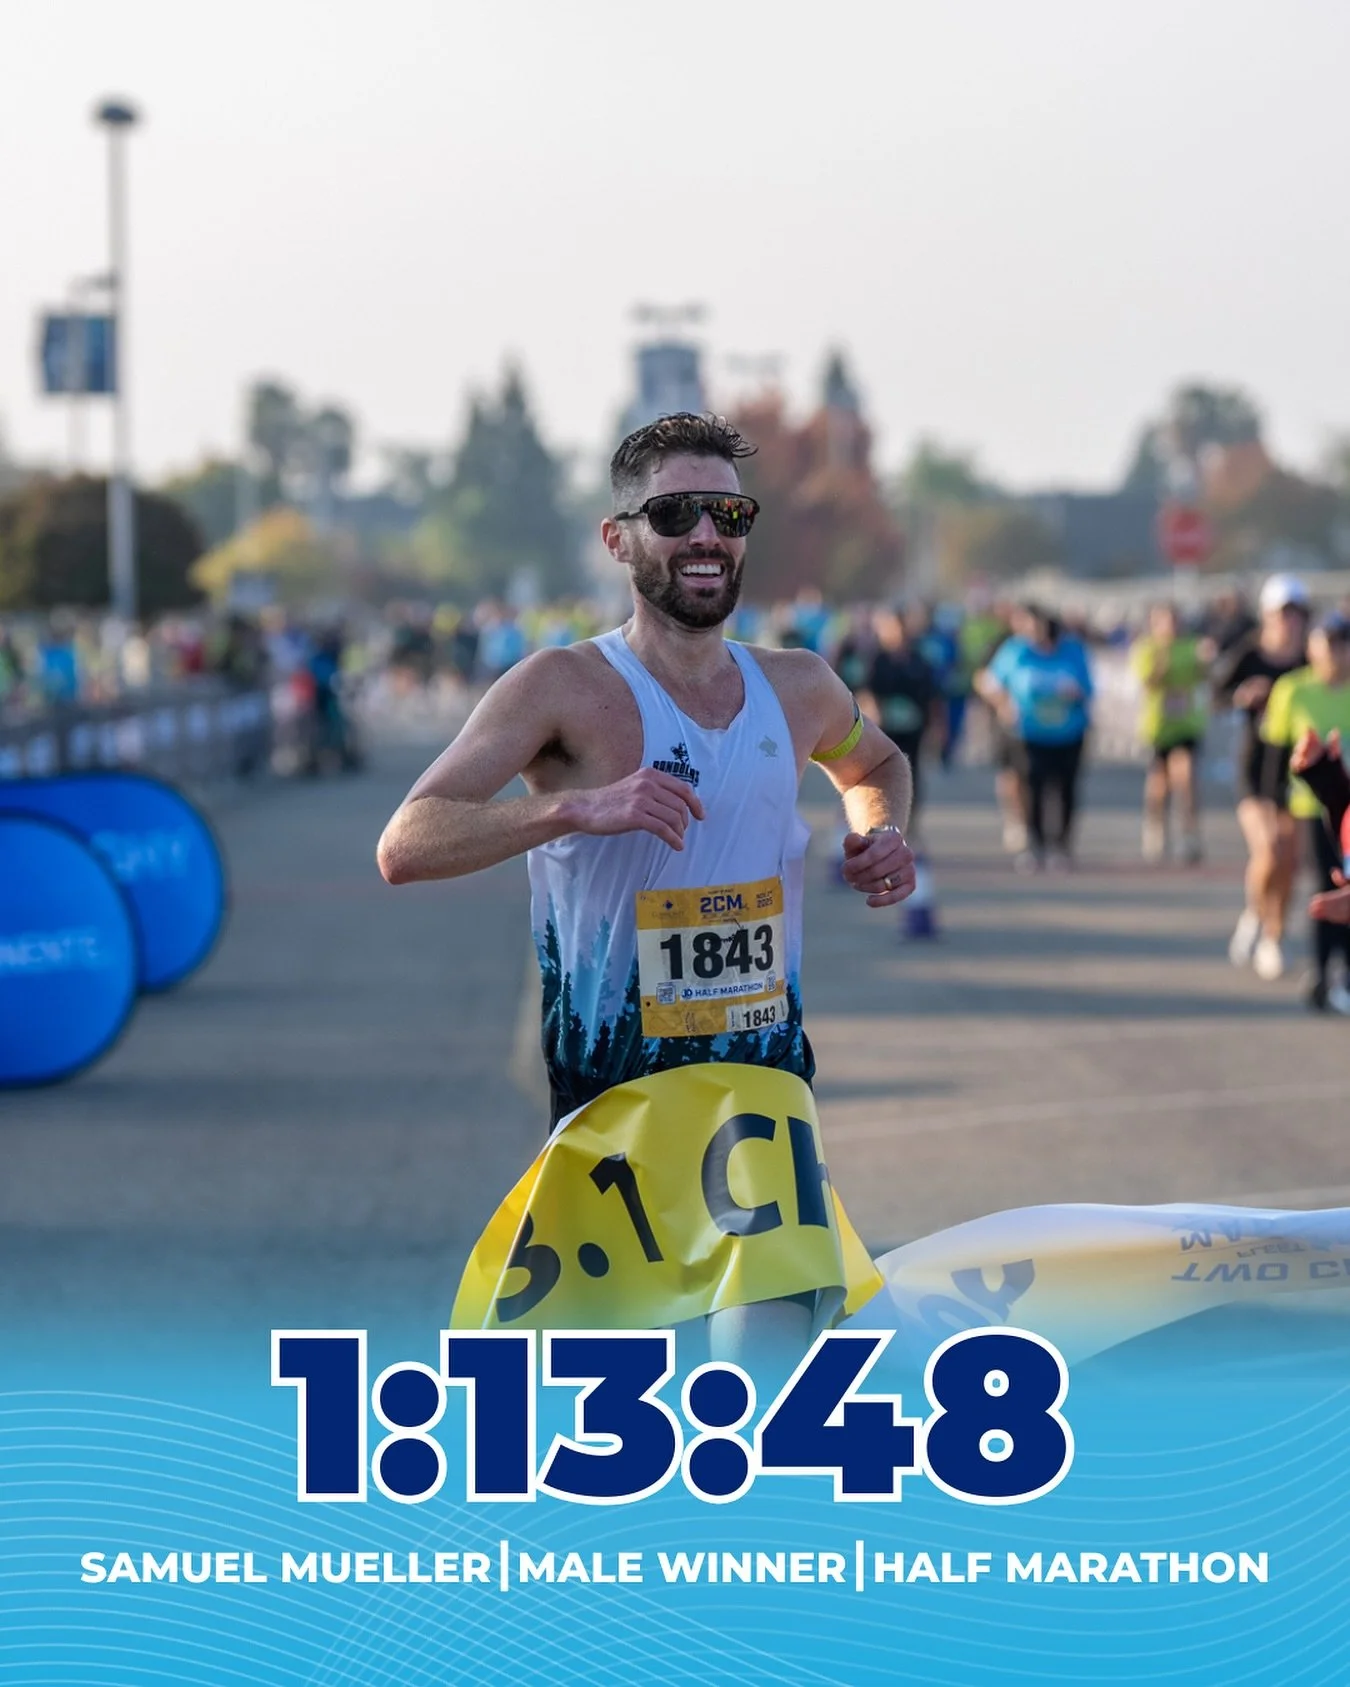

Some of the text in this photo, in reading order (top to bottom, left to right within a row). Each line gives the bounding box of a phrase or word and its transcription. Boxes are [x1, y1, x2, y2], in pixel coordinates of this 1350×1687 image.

[700, 894, 743, 913] 2CM
[660, 924, 774, 980] 1843
[695, 988, 718, 998] HALF
[720, 981, 763, 995] MARATHON
[743, 1004, 776, 1029] 1843
